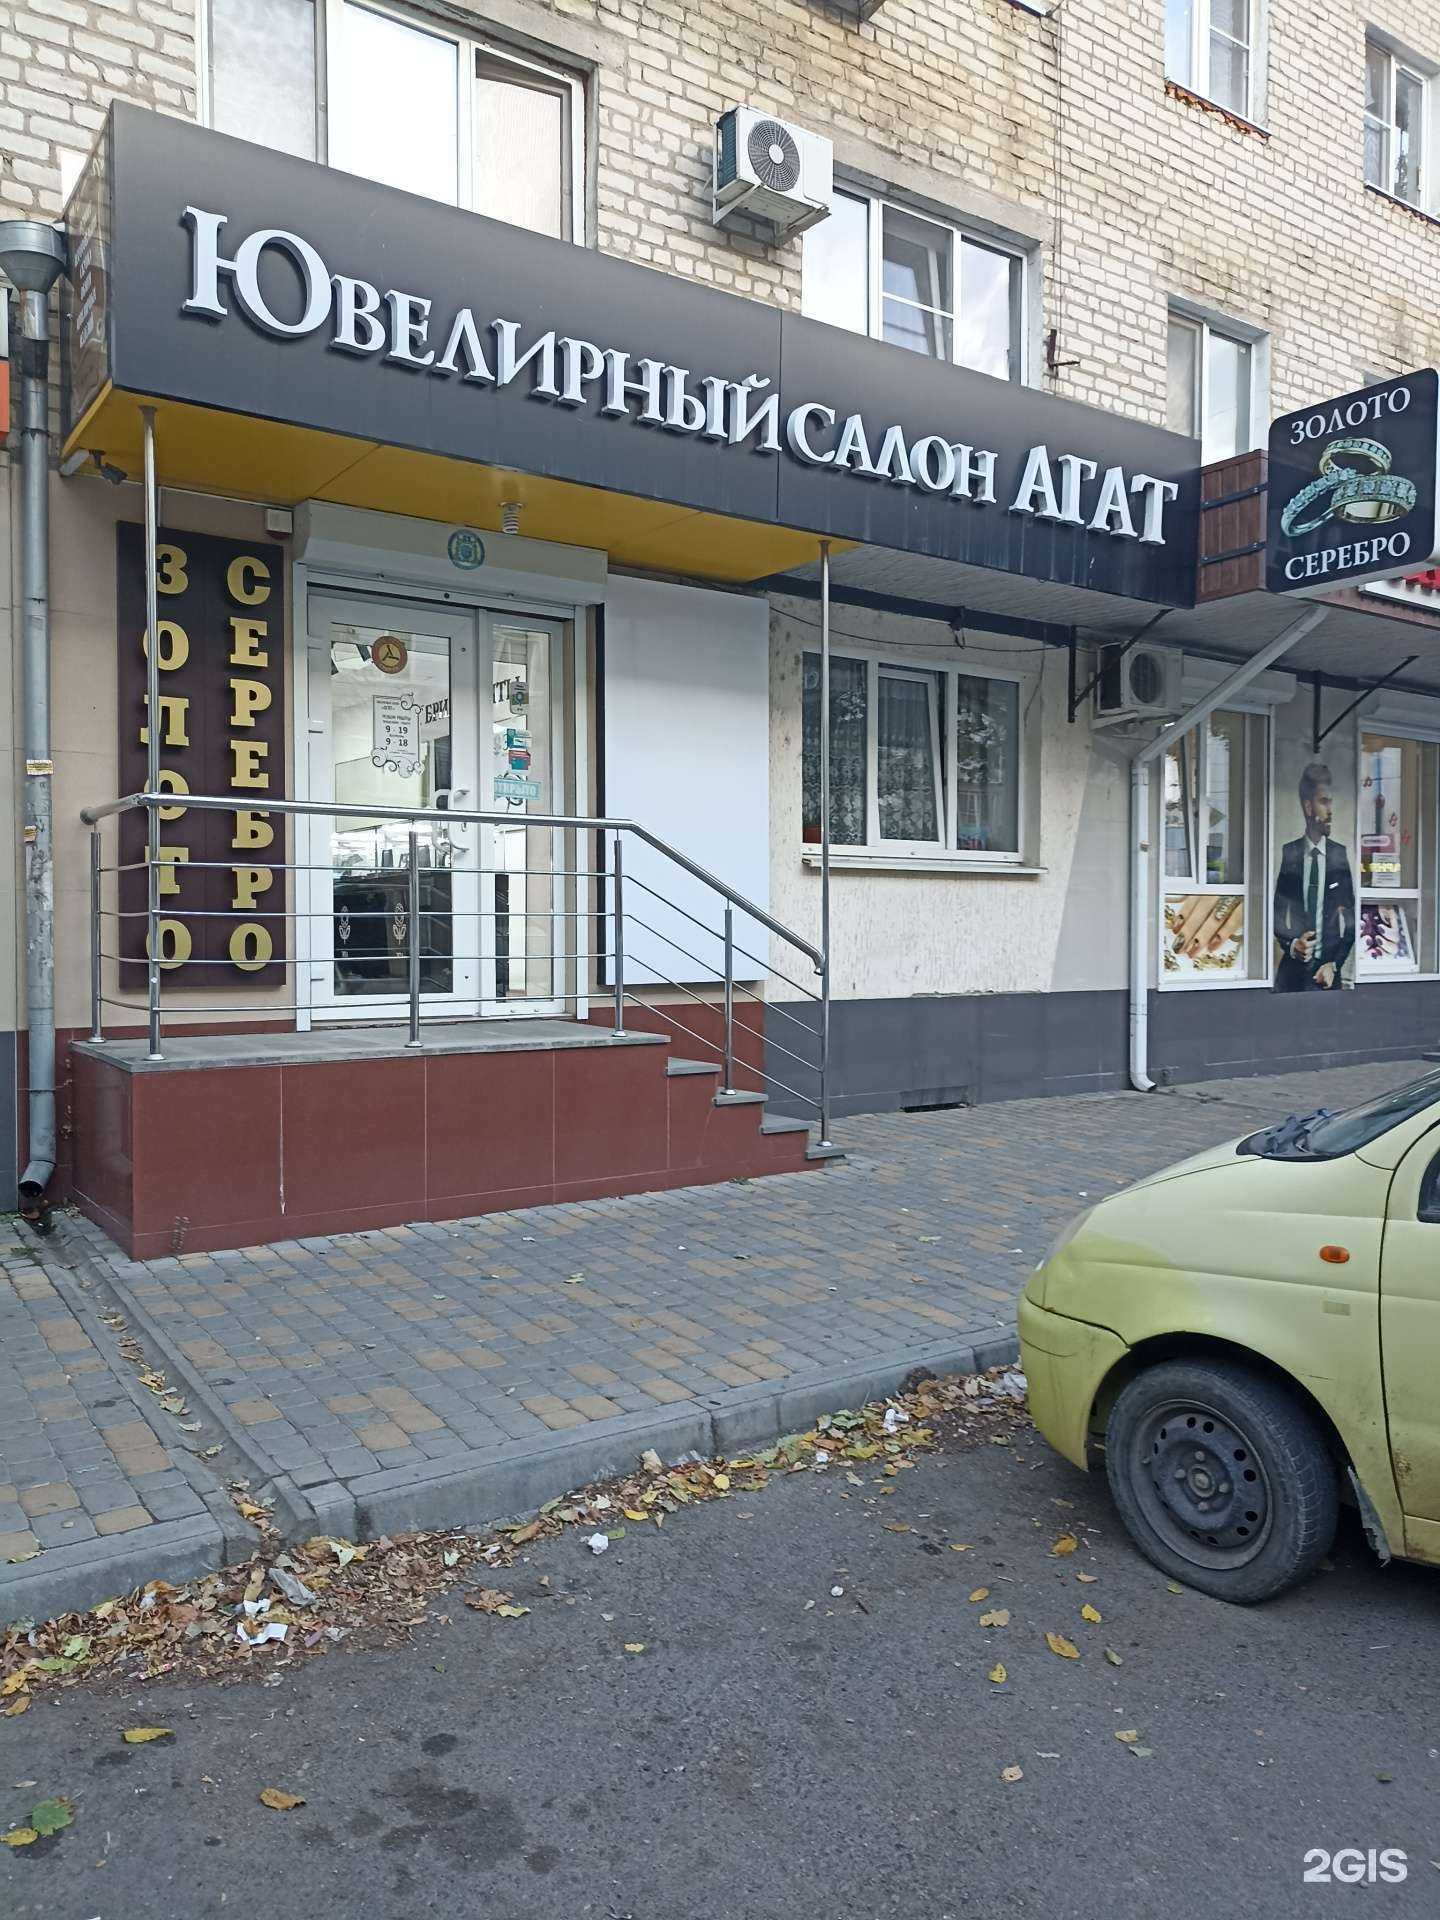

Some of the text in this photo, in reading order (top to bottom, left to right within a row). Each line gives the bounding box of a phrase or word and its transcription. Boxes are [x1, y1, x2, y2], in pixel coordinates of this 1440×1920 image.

[183, 205, 781, 452] ЮВЕЛИРНЫЙ
[786, 402, 998, 506] САЛОН
[1009, 445, 1178, 546] АГАТ
[1290, 387, 1411, 445] ЗОЛОТО
[1284, 531, 1411, 581] СЕРЕБРО
[140, 543, 193, 970] ЗОЛОТО
[385, 725, 391, 733] 9
[398, 726, 408, 735] 19
[385, 737, 391, 745] 9
[398, 738, 409, 747] 18
[227, 555, 274, 972] СЕРЕБРО
